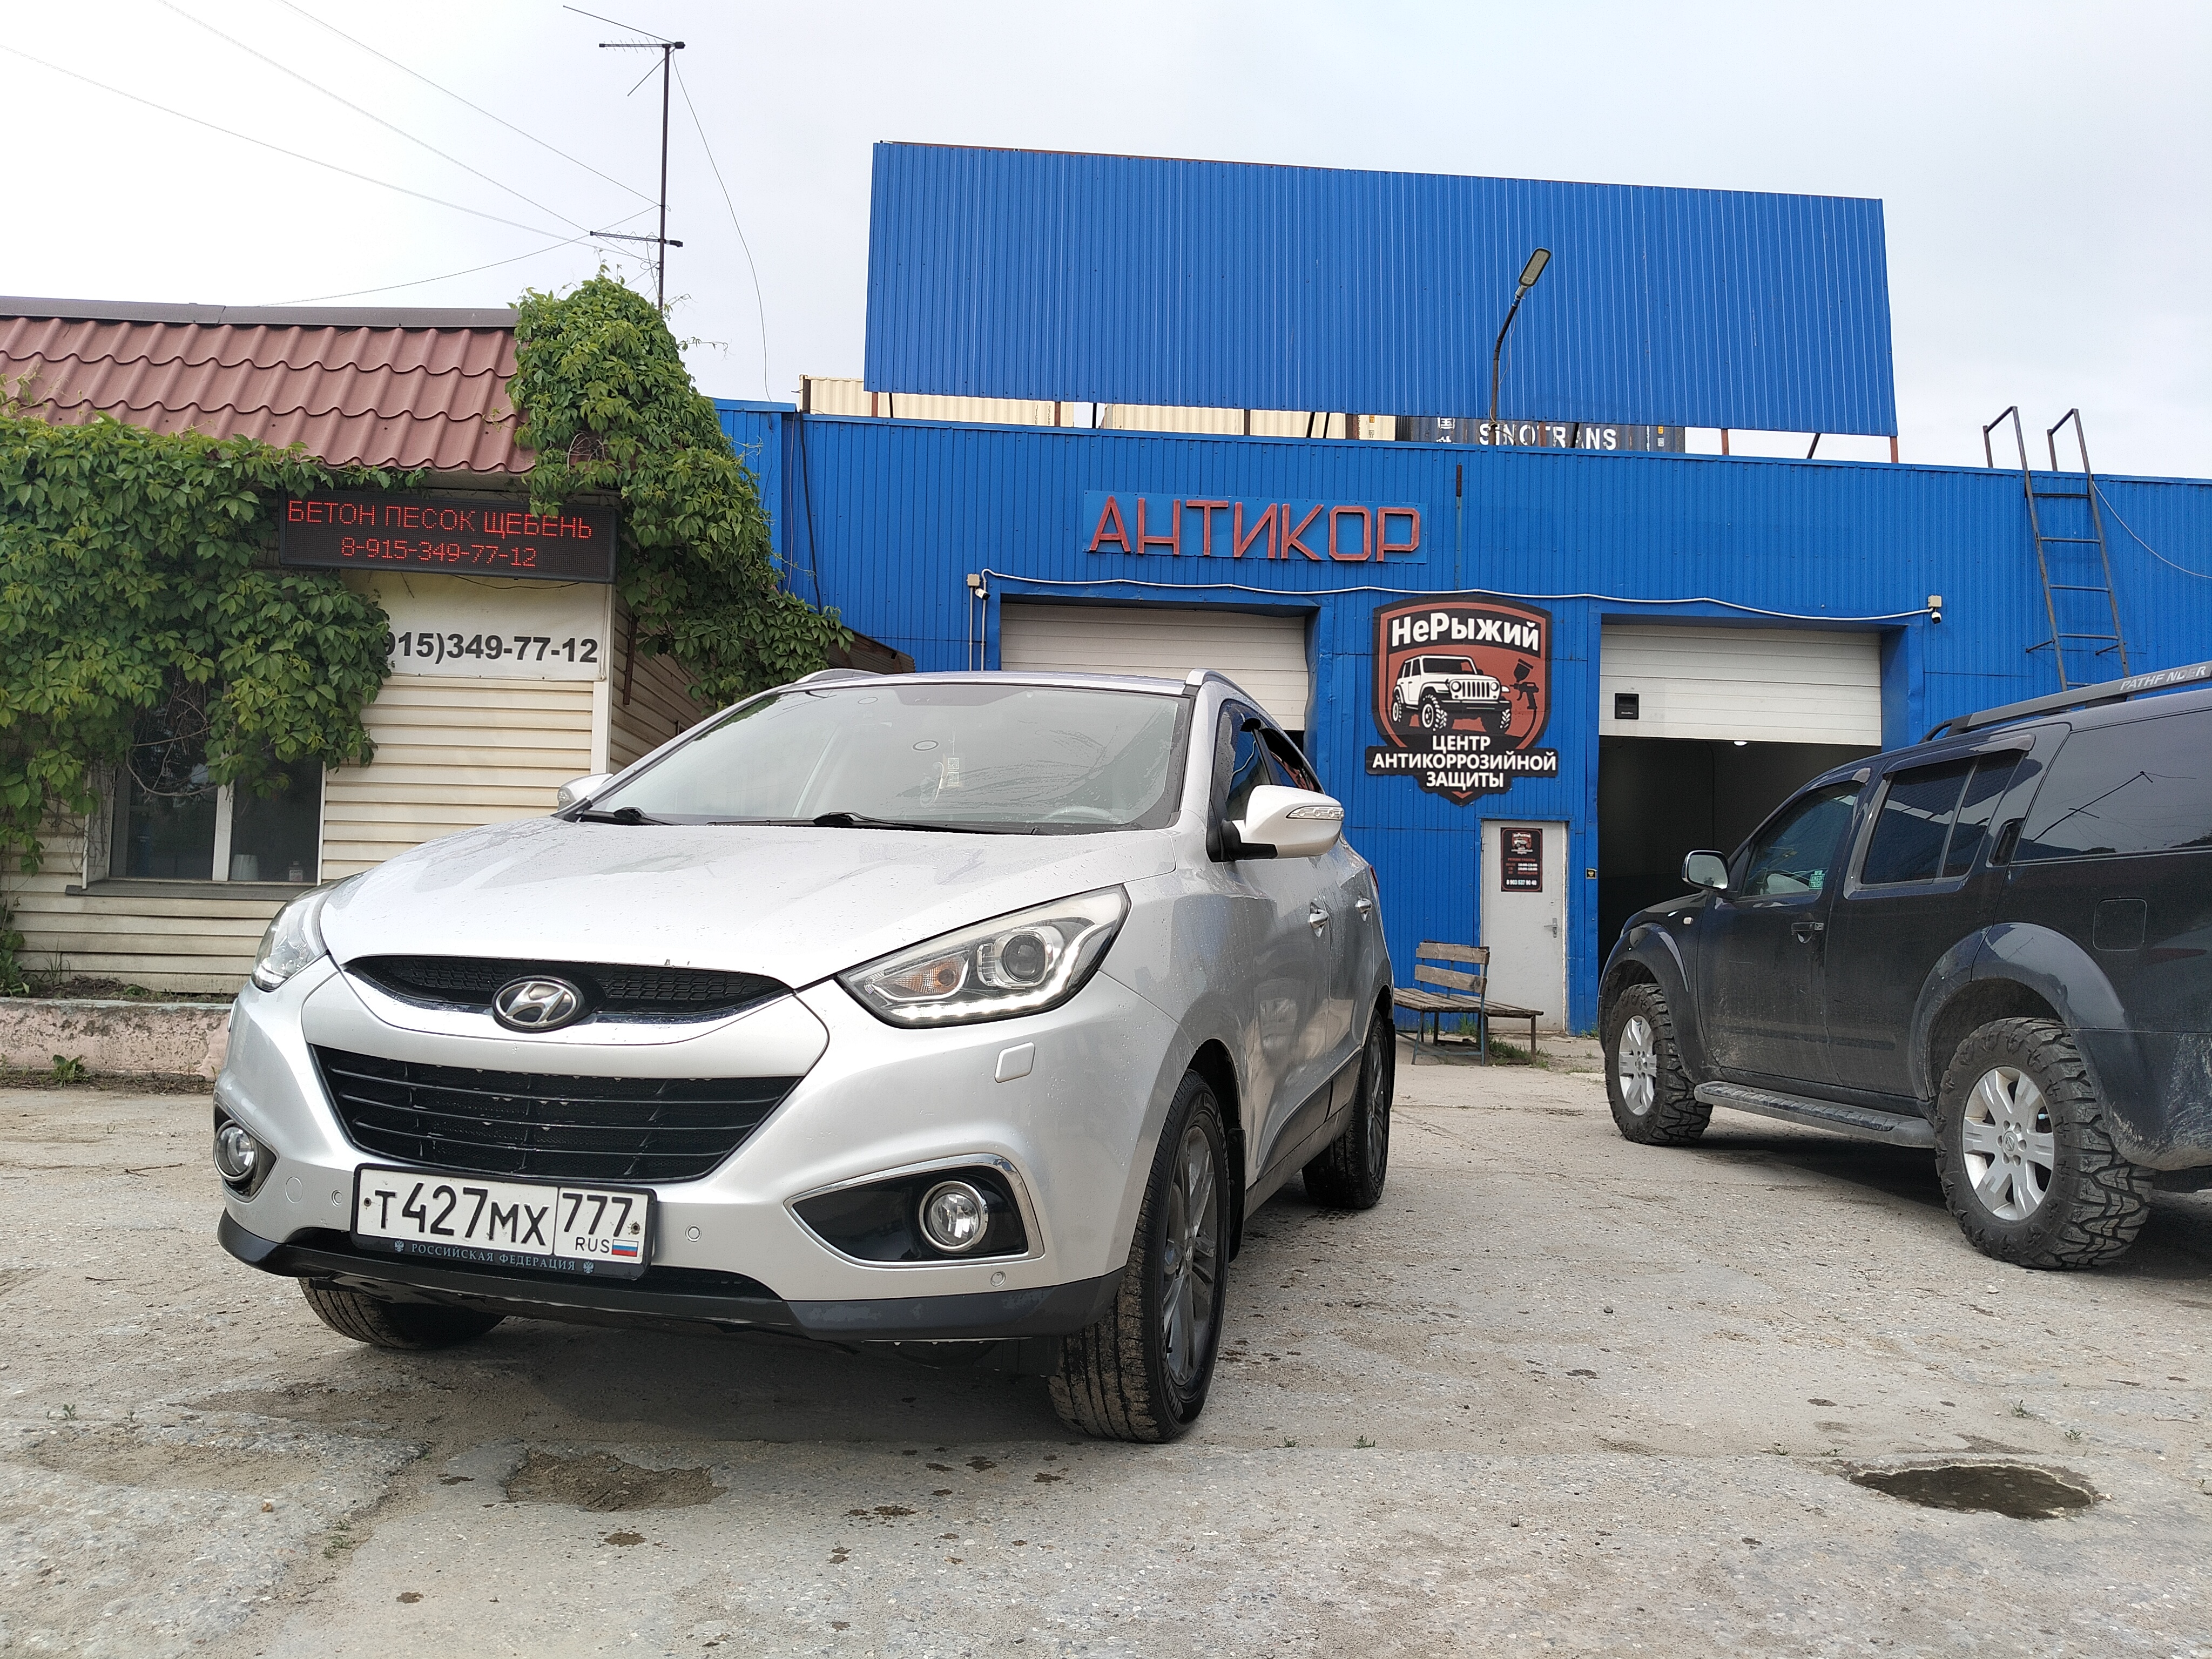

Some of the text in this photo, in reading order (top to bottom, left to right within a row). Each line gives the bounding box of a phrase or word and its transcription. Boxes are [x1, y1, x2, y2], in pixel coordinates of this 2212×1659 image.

[1479, 423, 1616, 450] SINORNS
[288, 500, 592, 539] БЕТОН ПЕСОК ЩЕБЕНЬ
[1089, 495, 1420, 562] АНТИКОР
[341, 537, 536, 567] 8-915-349-77-12
[1392, 612, 1539, 651] НеРыжий
[1432, 735, 1491, 754] ЦЕНТР
[1372, 751, 1556, 771] АНТИКОРРОЗИЙНОЙ
[1426, 771, 1504, 791] ЗАЩИТЫ
[562, 1192, 633, 1237] 777
[411, 1244, 576, 1271] РОССИЙСКАЯ ФЕДЕРАЦИЯ
[575, 1237, 611, 1254] RUS
